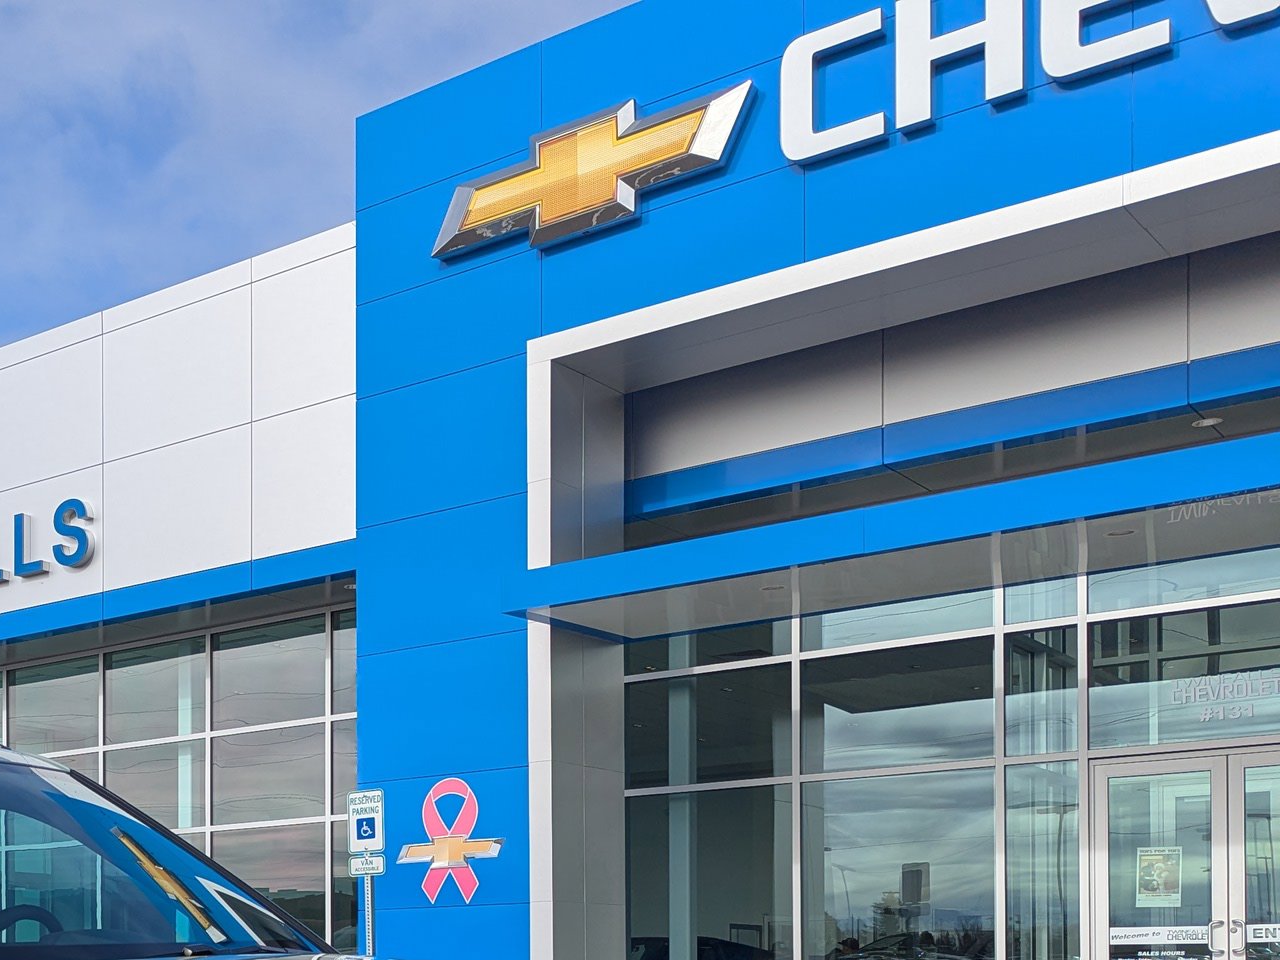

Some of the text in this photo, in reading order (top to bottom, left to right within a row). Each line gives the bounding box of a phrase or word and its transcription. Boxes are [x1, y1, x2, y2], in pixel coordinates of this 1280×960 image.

[1200, 703, 1254, 722] #131
[349, 794, 382, 806] RESERVED
[351, 806, 380, 816] PARKING
[360, 859, 374, 867] VAN
[1111, 932, 1149, 941] Welcome
